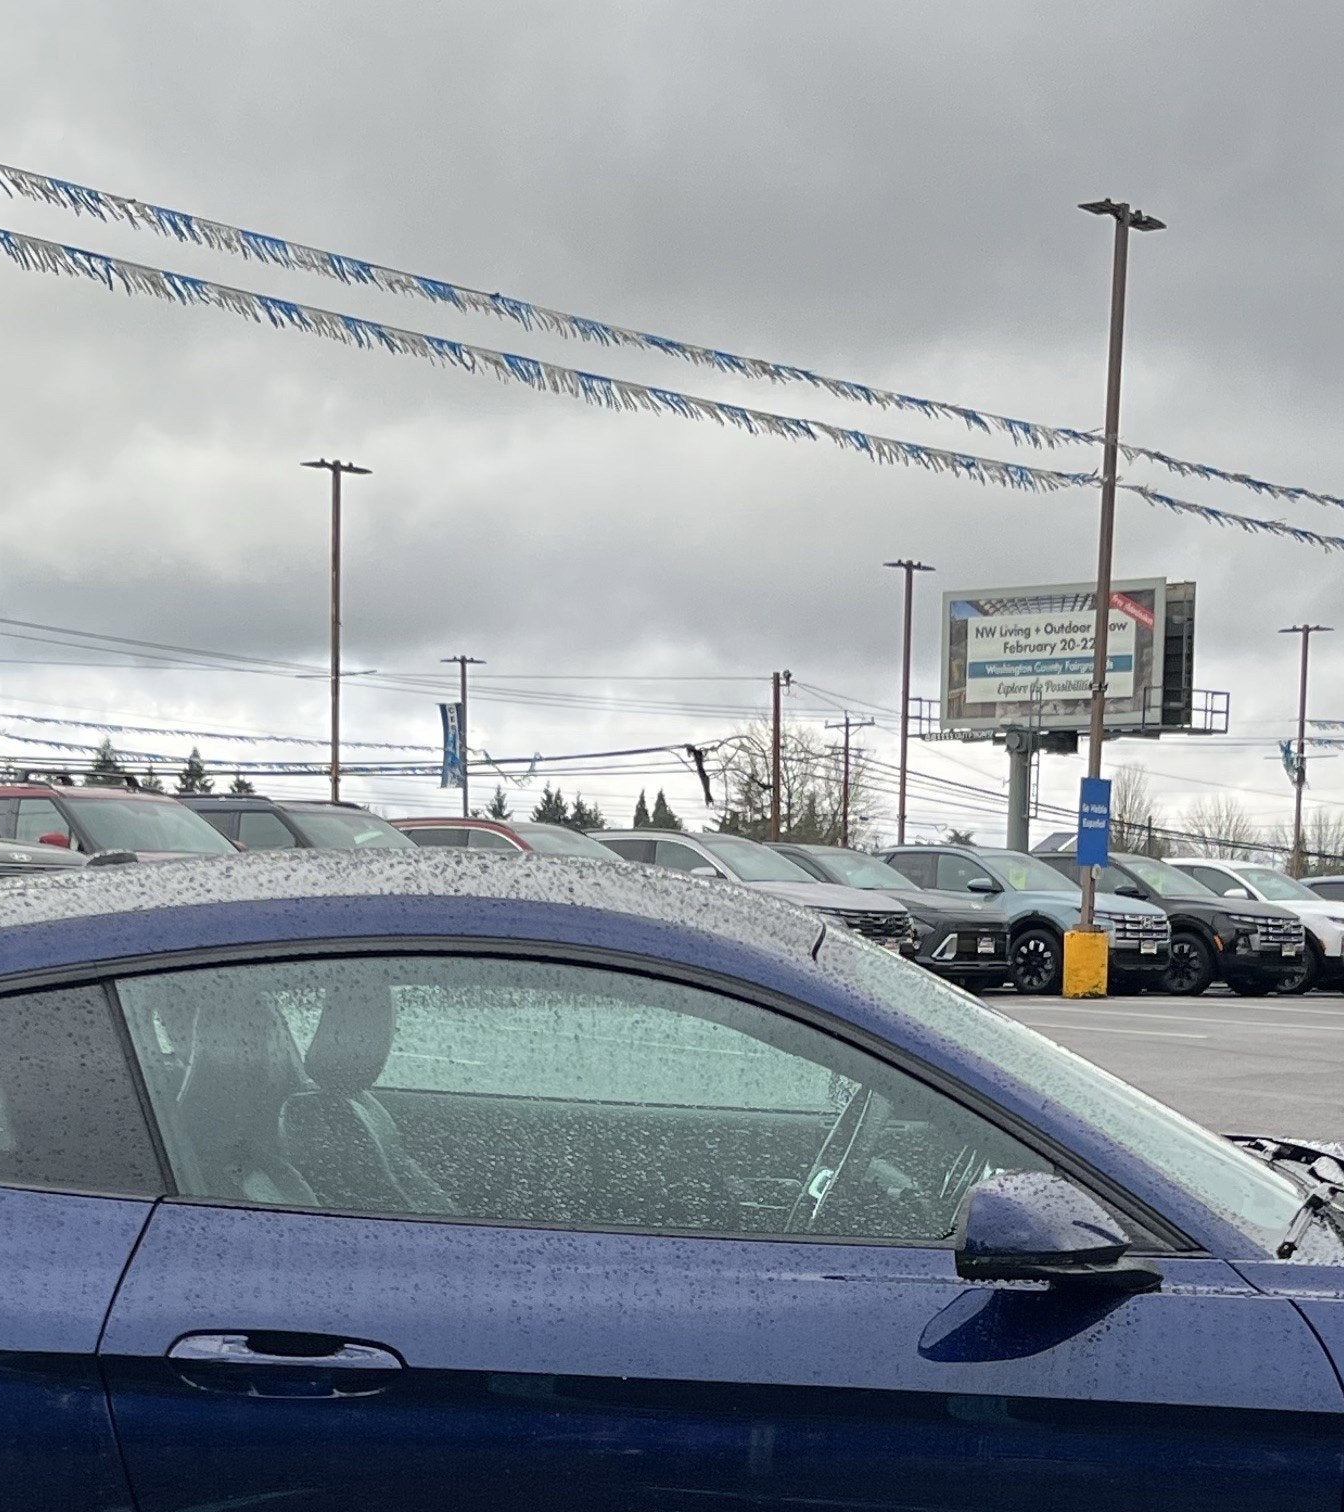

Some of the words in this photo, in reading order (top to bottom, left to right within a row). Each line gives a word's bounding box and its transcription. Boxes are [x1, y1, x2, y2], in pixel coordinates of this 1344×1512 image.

[975, 626, 997, 638] NW
[999, 624, 1031, 639] Living
[1043, 620, 1092, 635] Outdoor
[1108, 621, 1129, 632] ow
[1003, 640, 1057, 656] February
